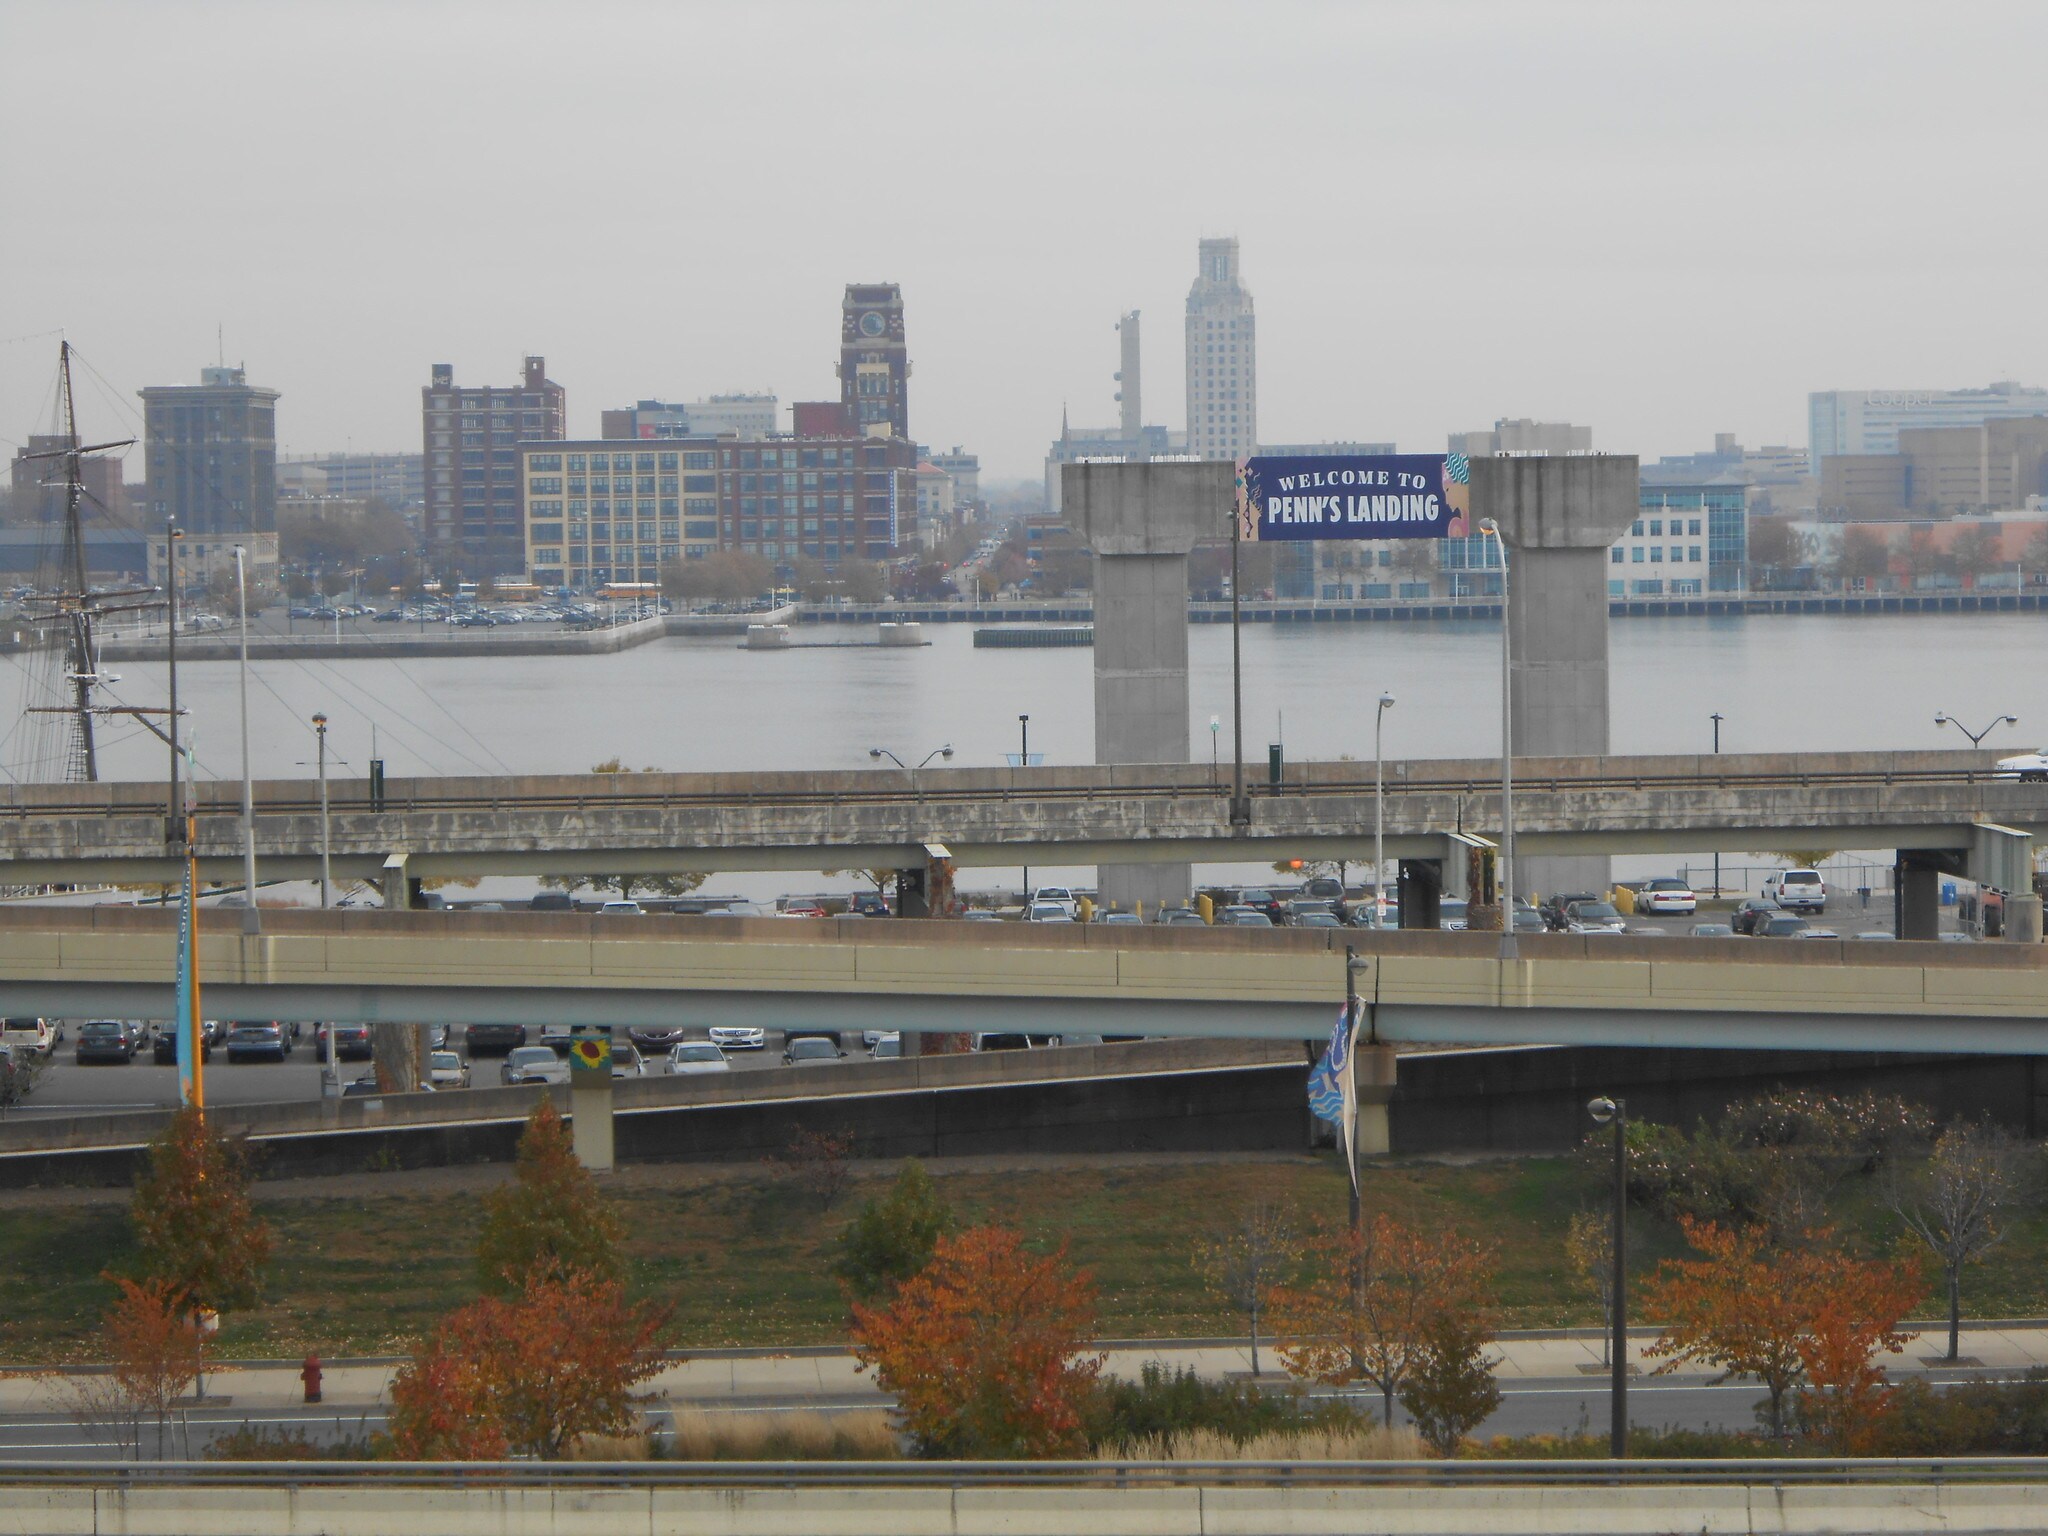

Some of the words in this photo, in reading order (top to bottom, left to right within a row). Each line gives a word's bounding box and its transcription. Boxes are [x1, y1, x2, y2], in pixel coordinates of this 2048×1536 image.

[1867, 389, 1932, 410] Cooper
[1278, 470, 1389, 491] WELCOME
[1397, 472, 1426, 489] TO
[1268, 495, 1342, 523] PENN'S
[1347, 494, 1439, 522] LANDING
